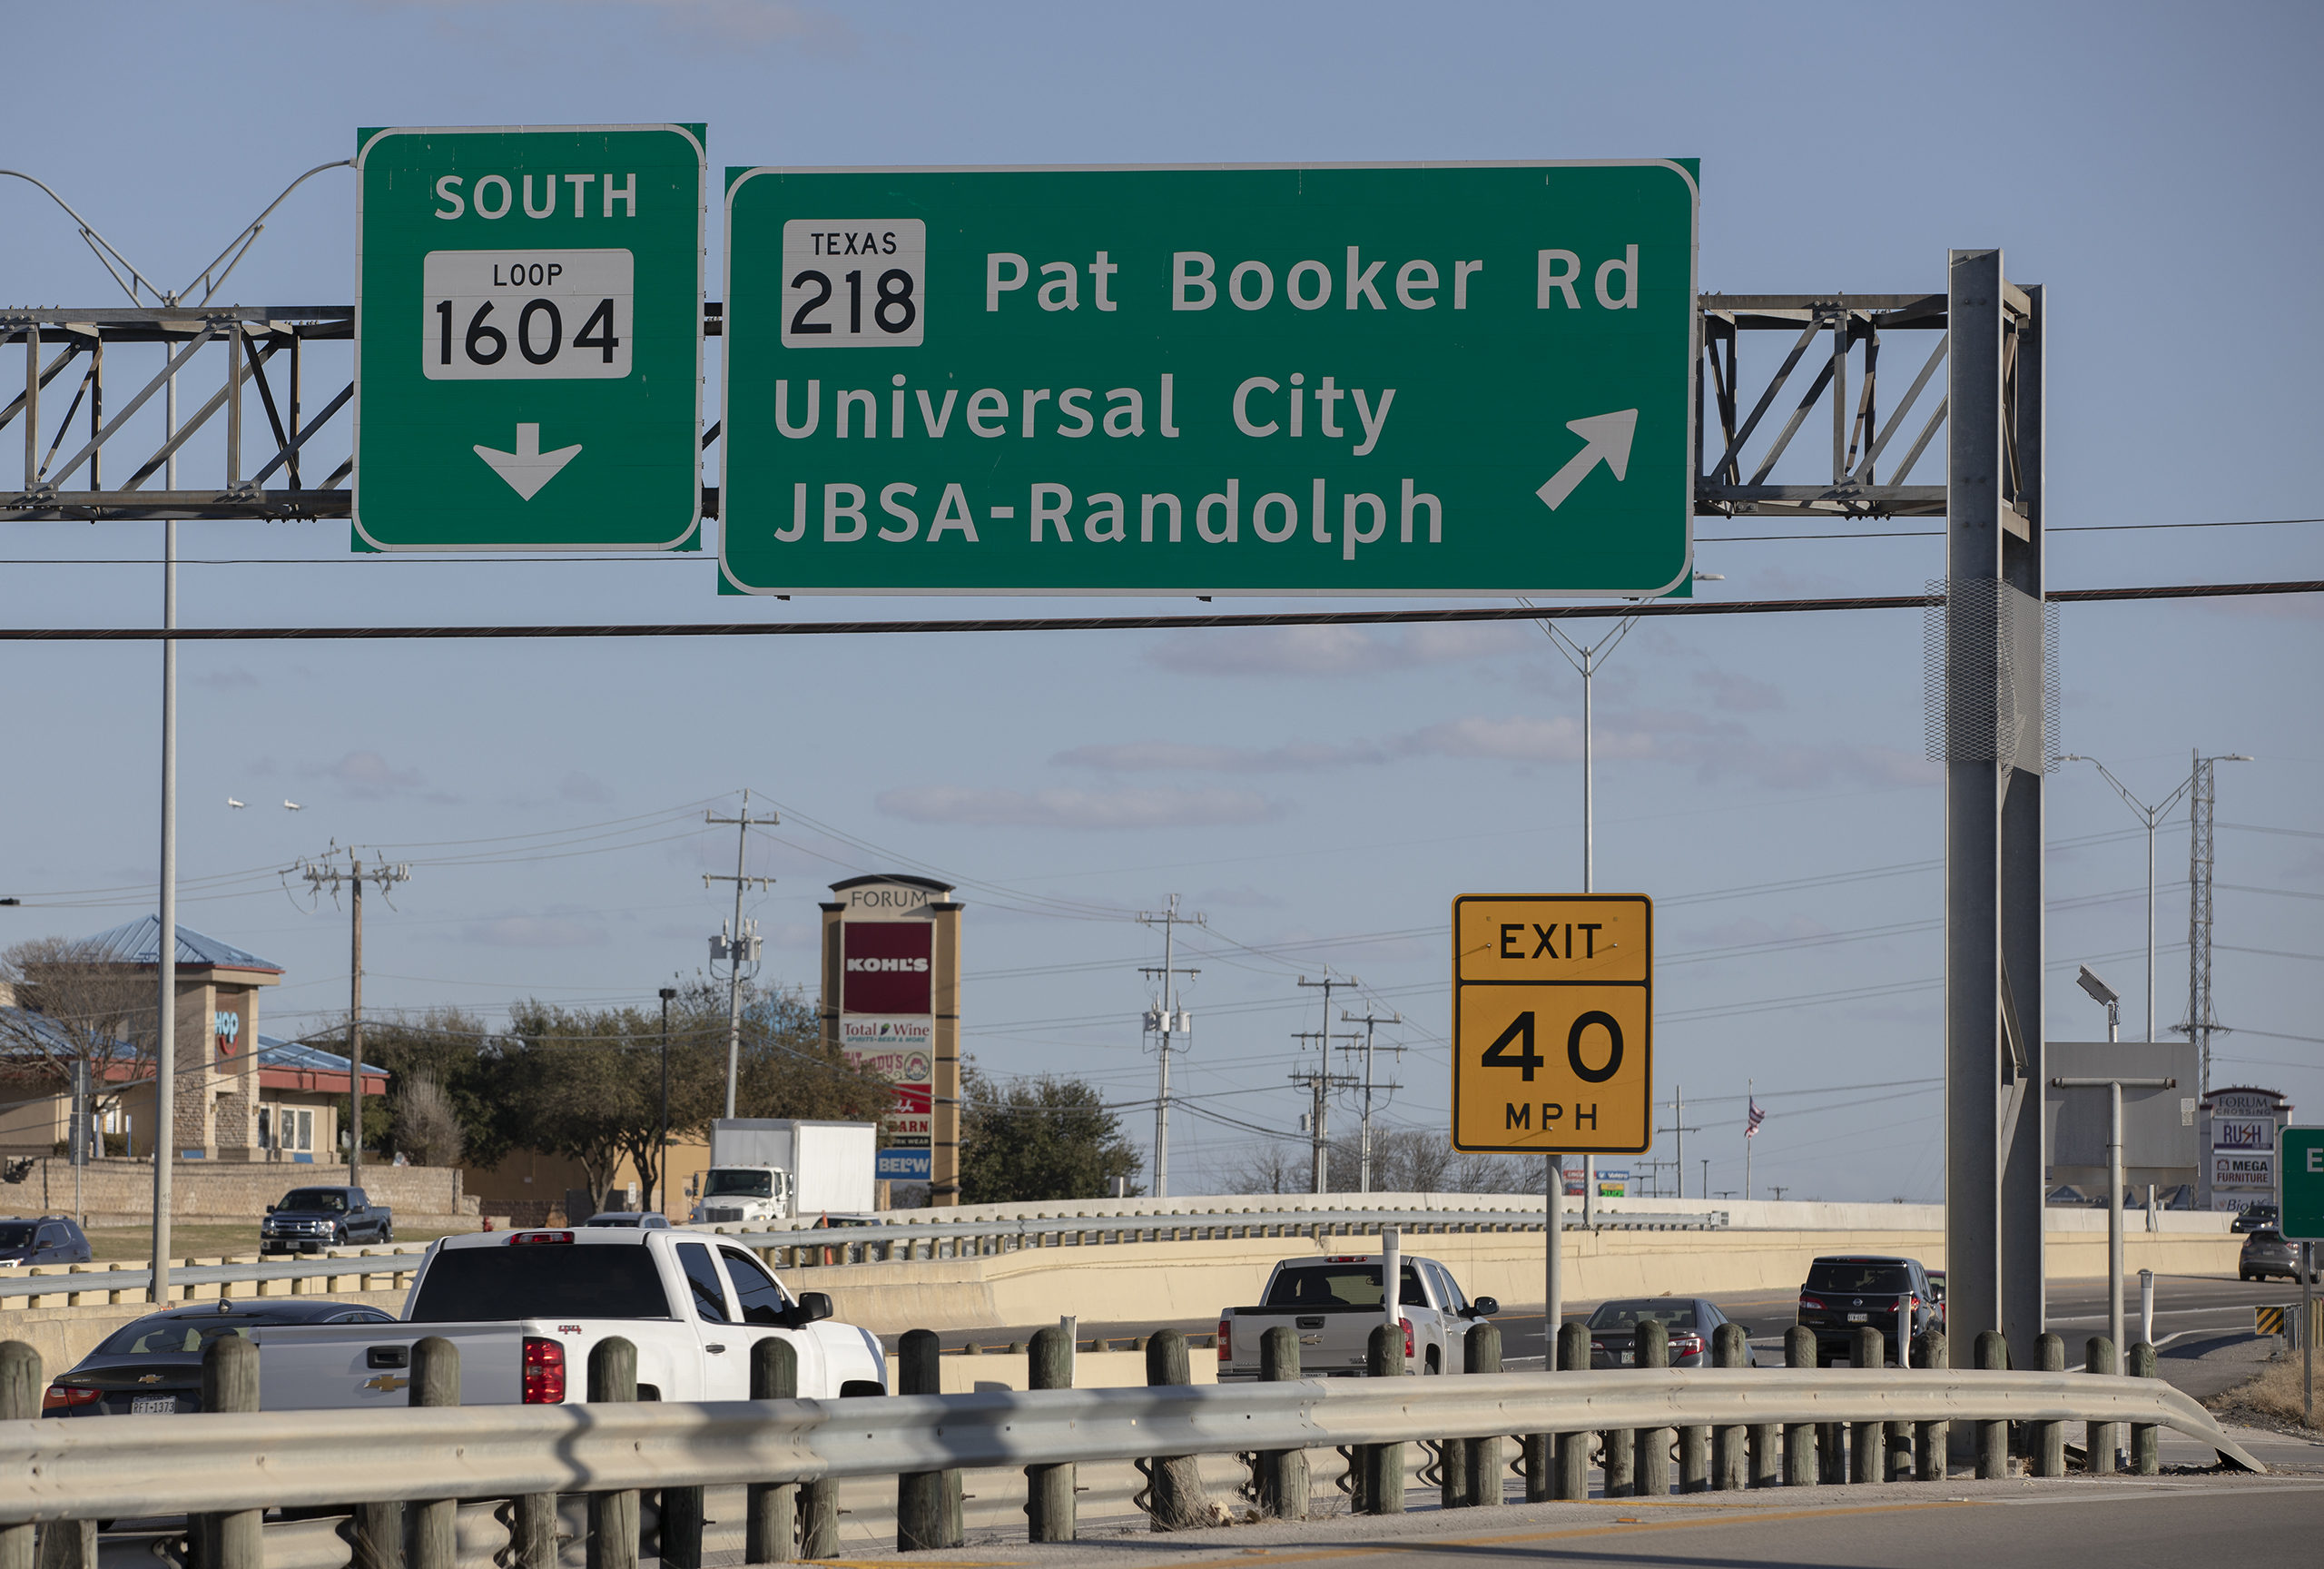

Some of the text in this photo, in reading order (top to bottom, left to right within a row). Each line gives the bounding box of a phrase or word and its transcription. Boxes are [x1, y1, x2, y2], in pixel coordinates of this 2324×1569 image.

[430, 173, 636, 221] SOUTH
[811, 232, 898, 256] TEXAS
[493, 263, 564, 287] LOOP
[986, 243, 1640, 312] Pat Booker Rd
[790, 268, 917, 335] 218
[435, 298, 620, 366] 1604
[774, 372, 1396, 457] Universal City
[773, 478, 1443, 560] JBSA-Randolph
[852, 891, 929, 907] FORUM
[1500, 923, 1603, 960] EXIT
[847, 957, 930, 972] KOHL'S
[214, 1011, 239, 1043] HOP
[844, 1022, 931, 1036] Total Wine
[1481, 1010, 1624, 1083] 40
[1505, 1102, 1597, 1130] MPH
[2219, 1096, 2268, 1108] FORUM
[879, 1157, 931, 1173] BELOW
[2216, 1172, 2269, 1183] FURNITURE
[2232, 1159, 2269, 1171] MEGA
